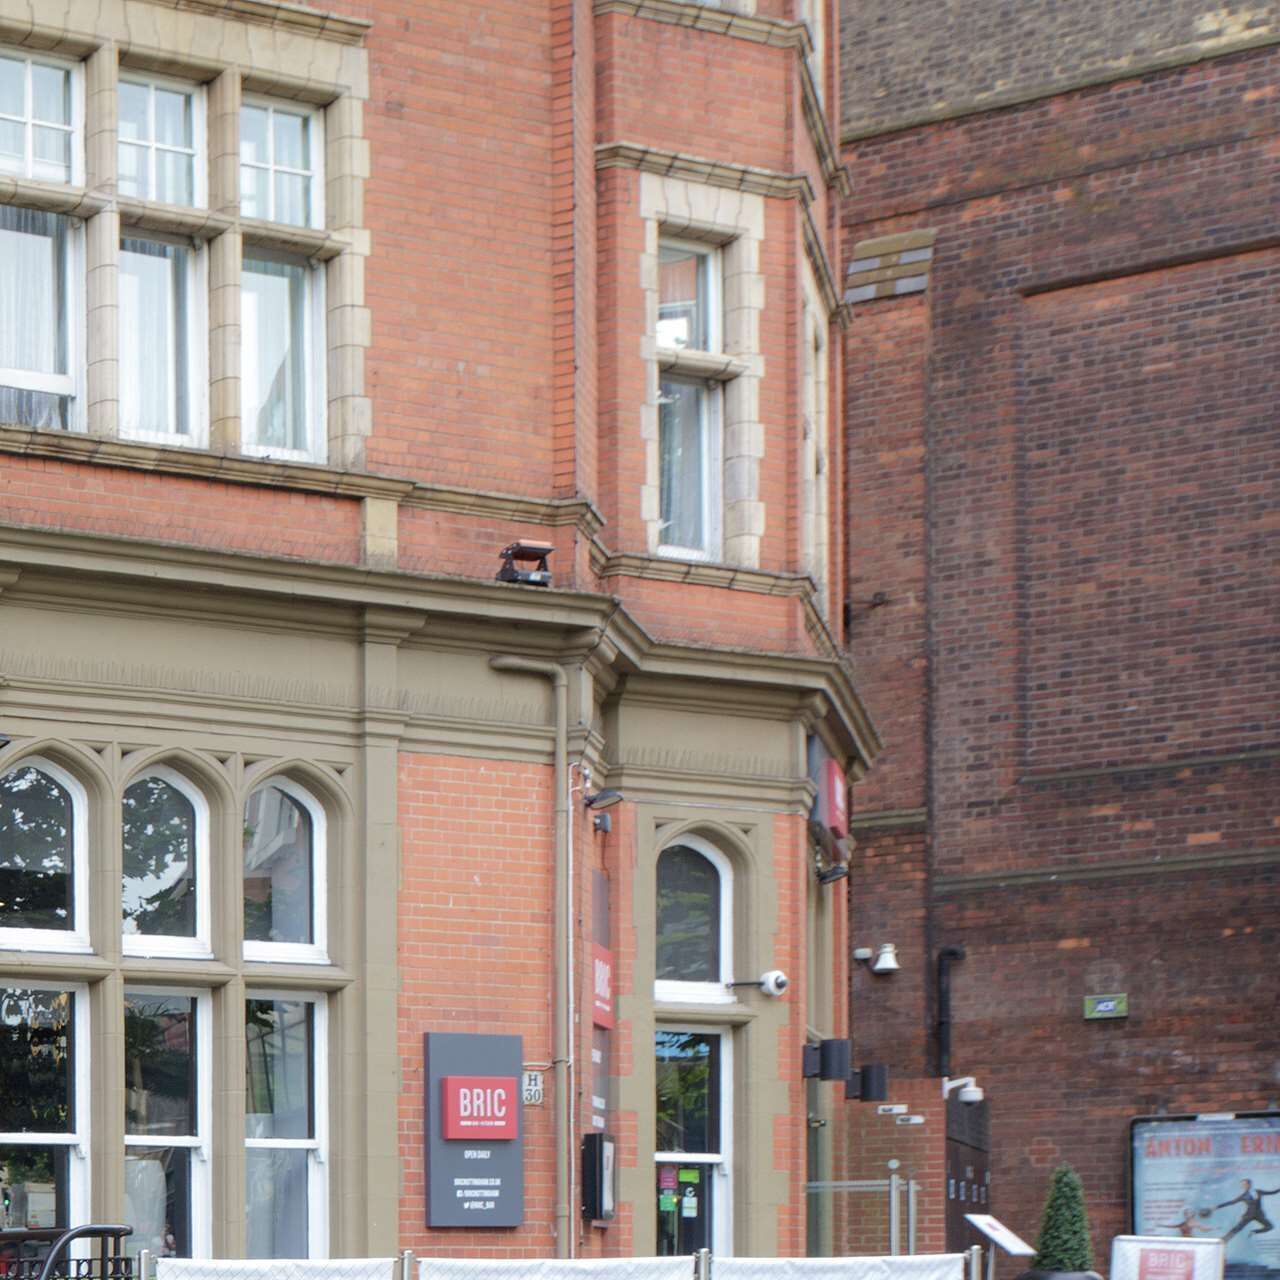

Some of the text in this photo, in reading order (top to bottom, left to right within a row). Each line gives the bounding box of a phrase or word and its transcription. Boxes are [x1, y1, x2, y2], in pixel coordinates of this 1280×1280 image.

[528, 1074, 538, 1087] H
[459, 1088, 506, 1117] BRIC
[525, 1089, 541, 1103] 30
